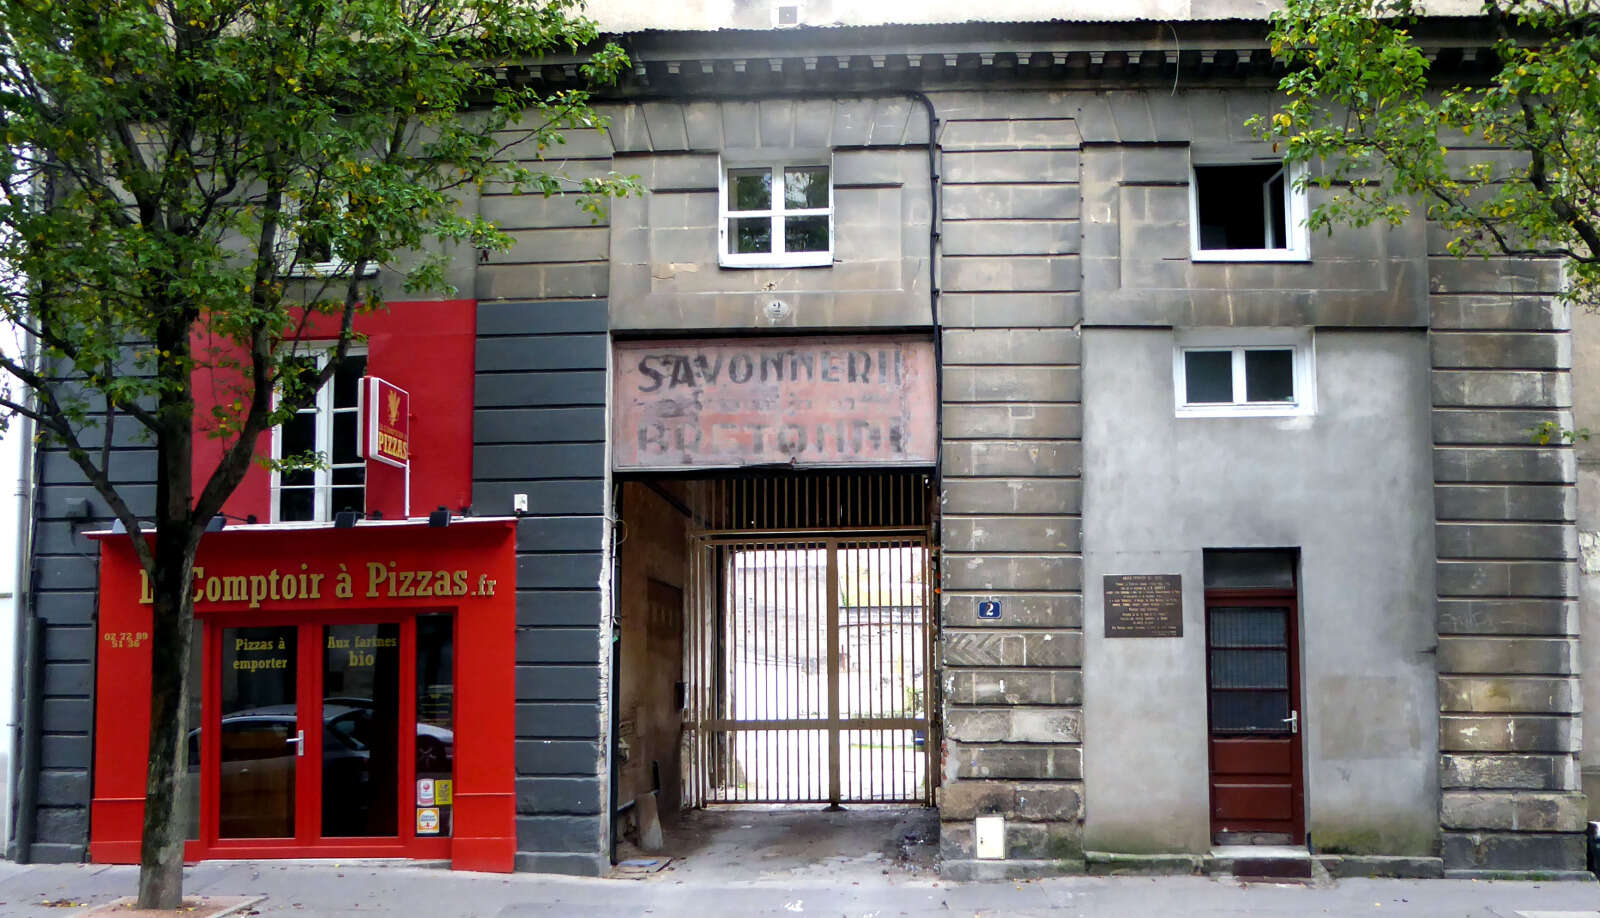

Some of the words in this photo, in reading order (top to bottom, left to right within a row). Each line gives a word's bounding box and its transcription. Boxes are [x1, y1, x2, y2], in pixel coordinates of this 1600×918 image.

[378, 431, 408, 460] PIZZAS
[191, 563, 325, 608] Comptoir
[335, 563, 353, 598] à
[986, 602, 994, 616] 2
[235, 638, 274, 651] Pizzas
[278, 637, 286, 649] à
[327, 636, 350, 649] Aux
[354, 635, 397, 648] farines
[233, 658, 288, 672] emporter
[349, 650, 375, 667] bio
